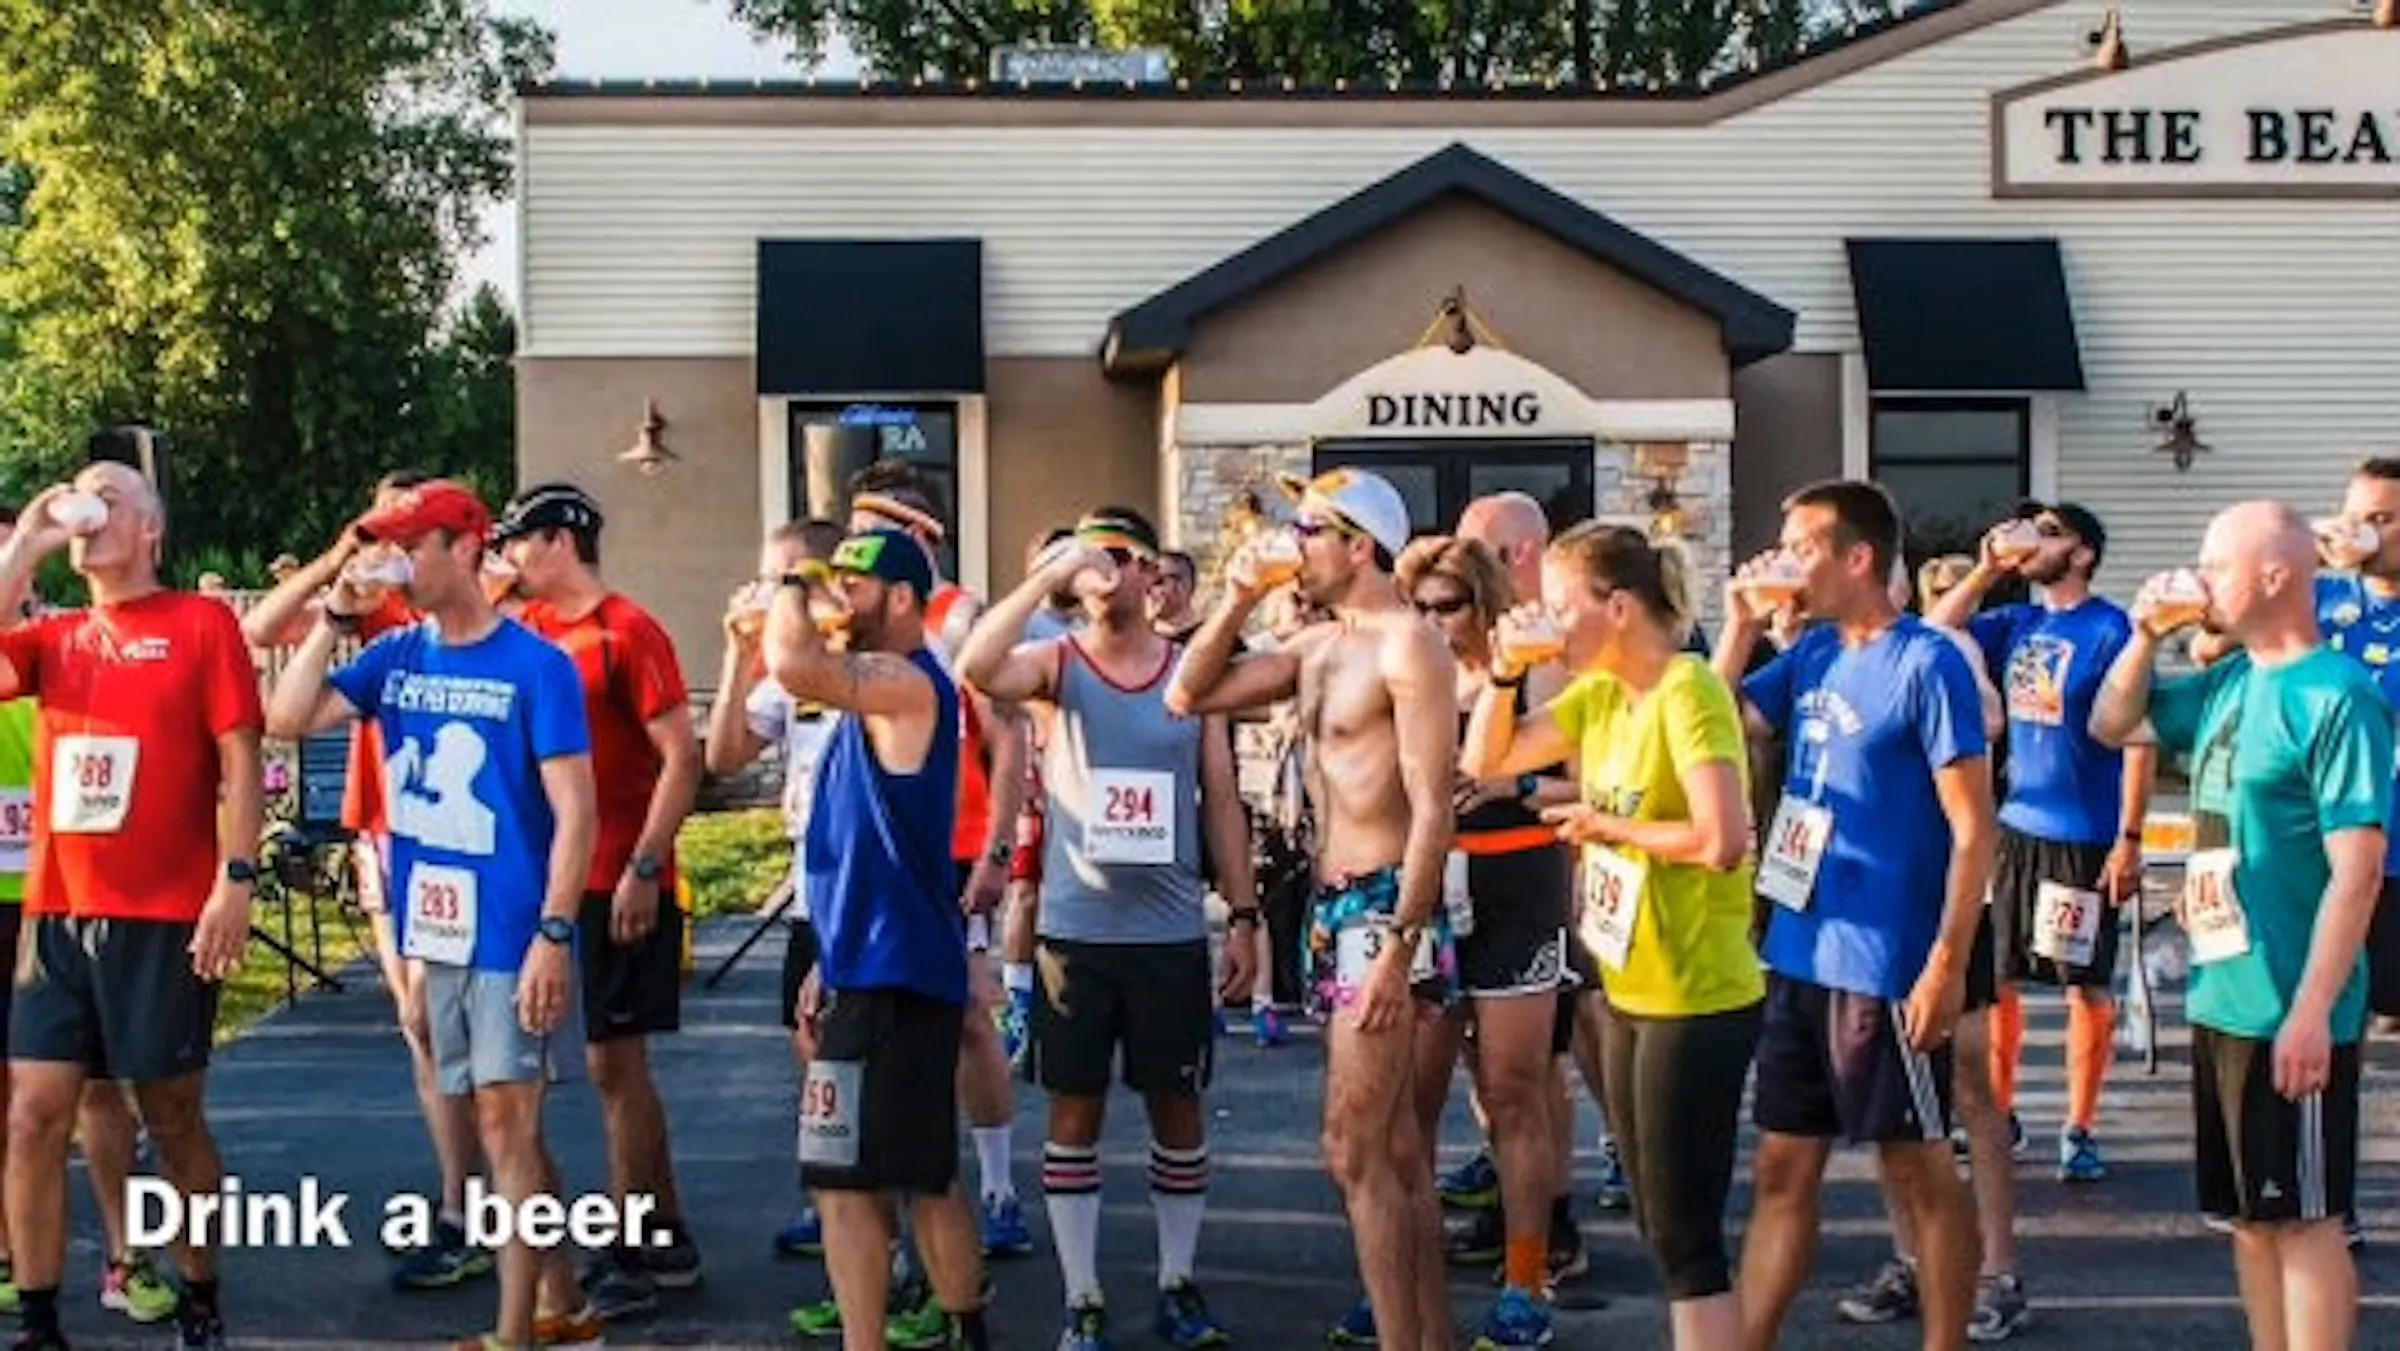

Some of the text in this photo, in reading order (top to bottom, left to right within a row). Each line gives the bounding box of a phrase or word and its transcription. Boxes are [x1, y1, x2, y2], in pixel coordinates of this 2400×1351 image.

[2044, 106, 2400, 163] THE BEA
[1368, 391, 1541, 426] DINING
[1105, 785, 1152, 822] 294
[420, 881, 458, 920] 283
[800, 1079, 836, 1118] 59
